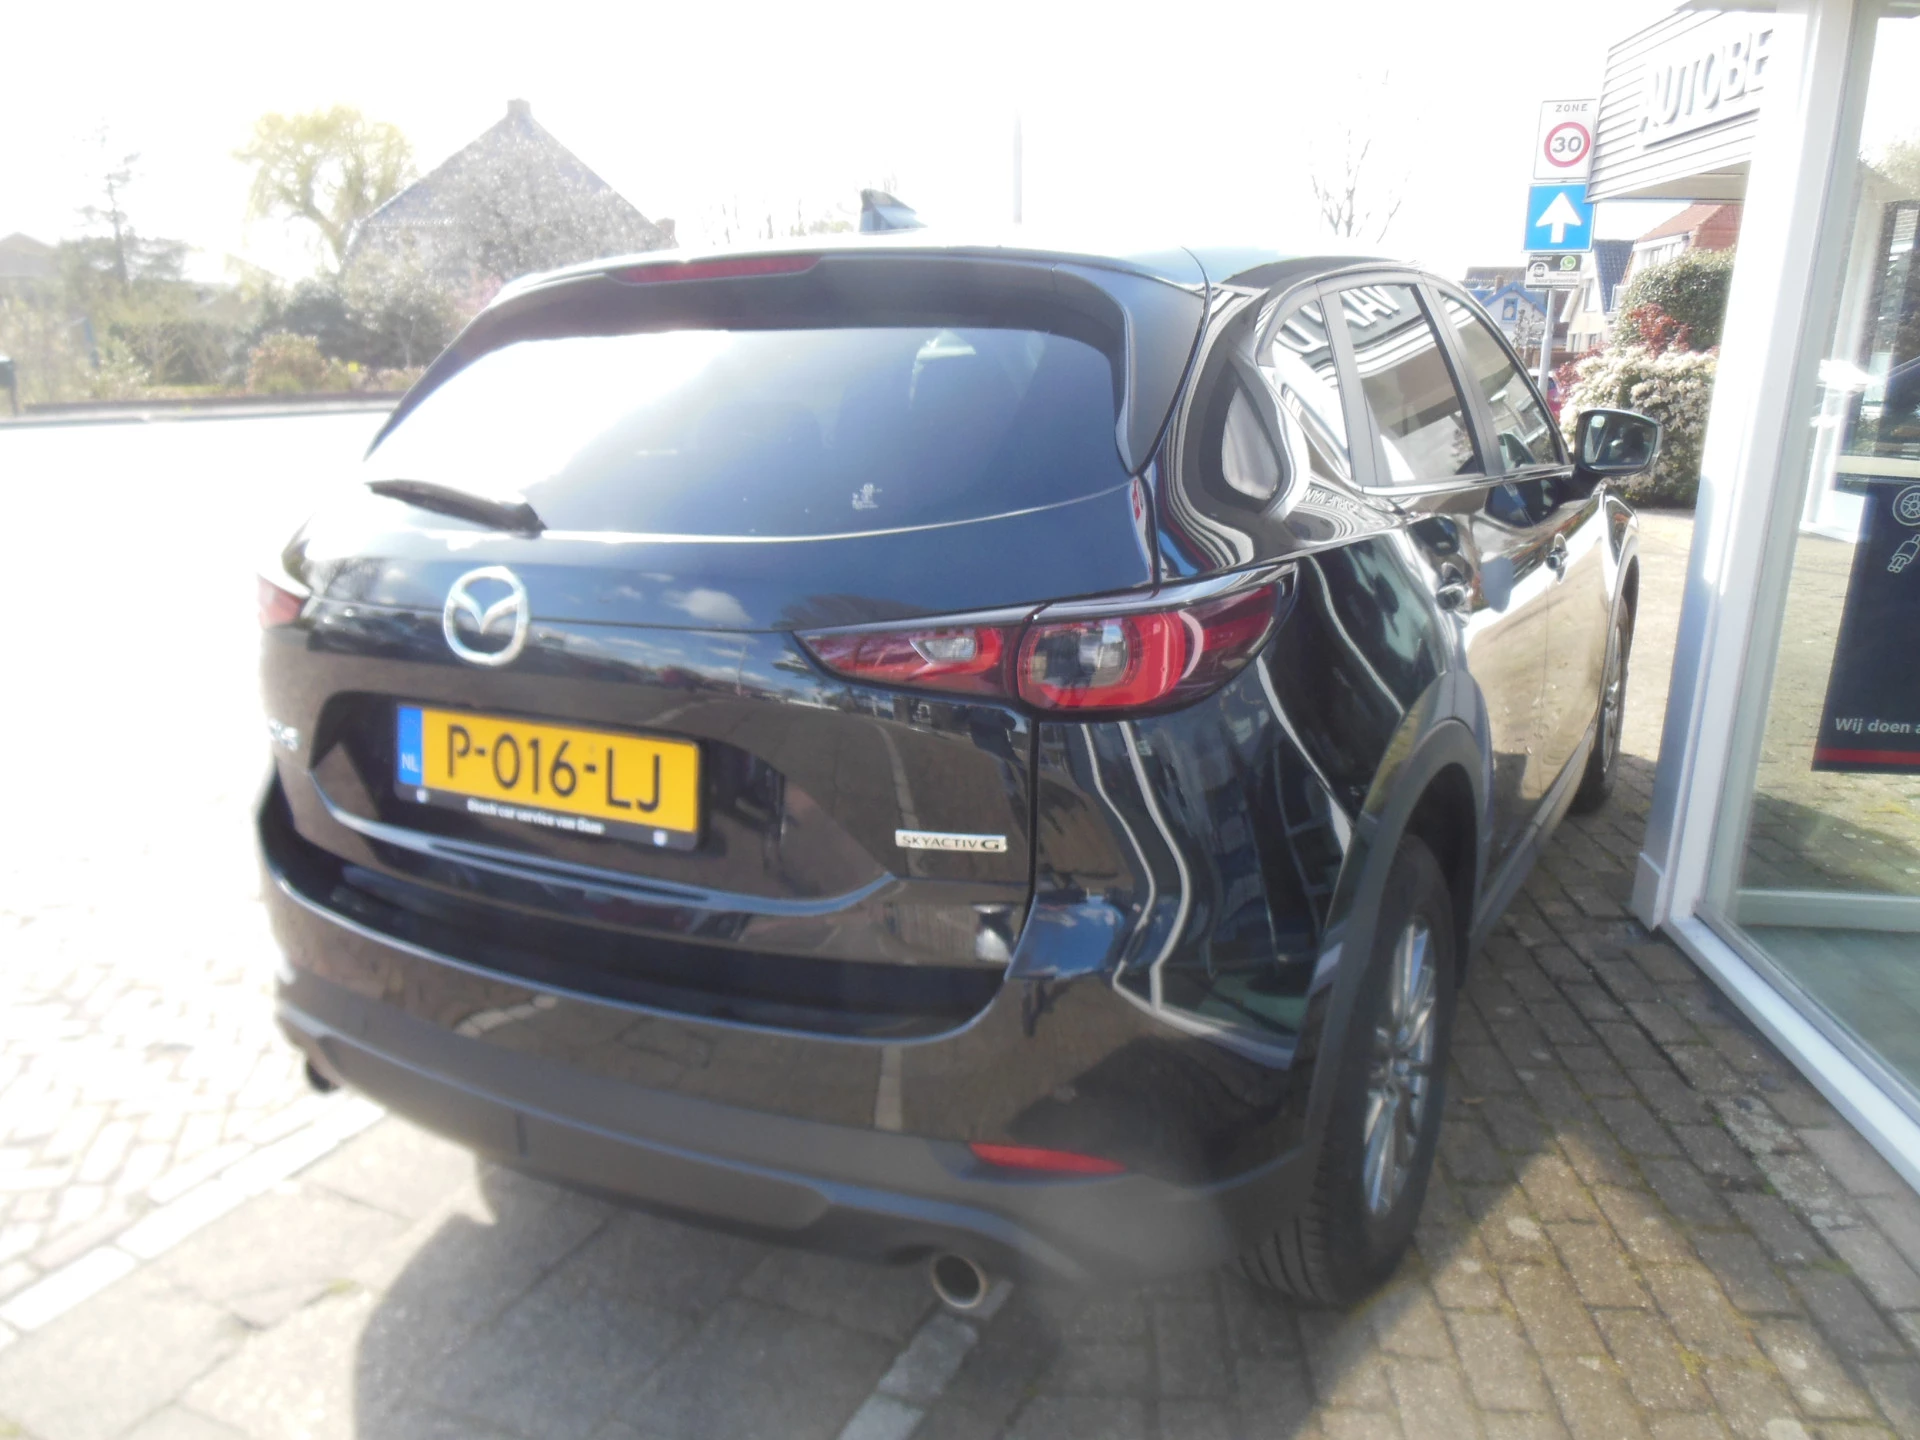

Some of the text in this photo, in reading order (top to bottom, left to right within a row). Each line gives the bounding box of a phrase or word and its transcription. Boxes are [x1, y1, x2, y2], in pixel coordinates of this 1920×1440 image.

[1555, 103, 1588, 113] ZONE
[1552, 136, 1582, 153] 30
[1835, 717, 1863, 735] Wij
[1867, 718, 1911, 734] doen
[401, 752, 420, 773] NL
[447, 723, 661, 813] P-016-LJ
[902, 835, 978, 849] SKYACTIV
